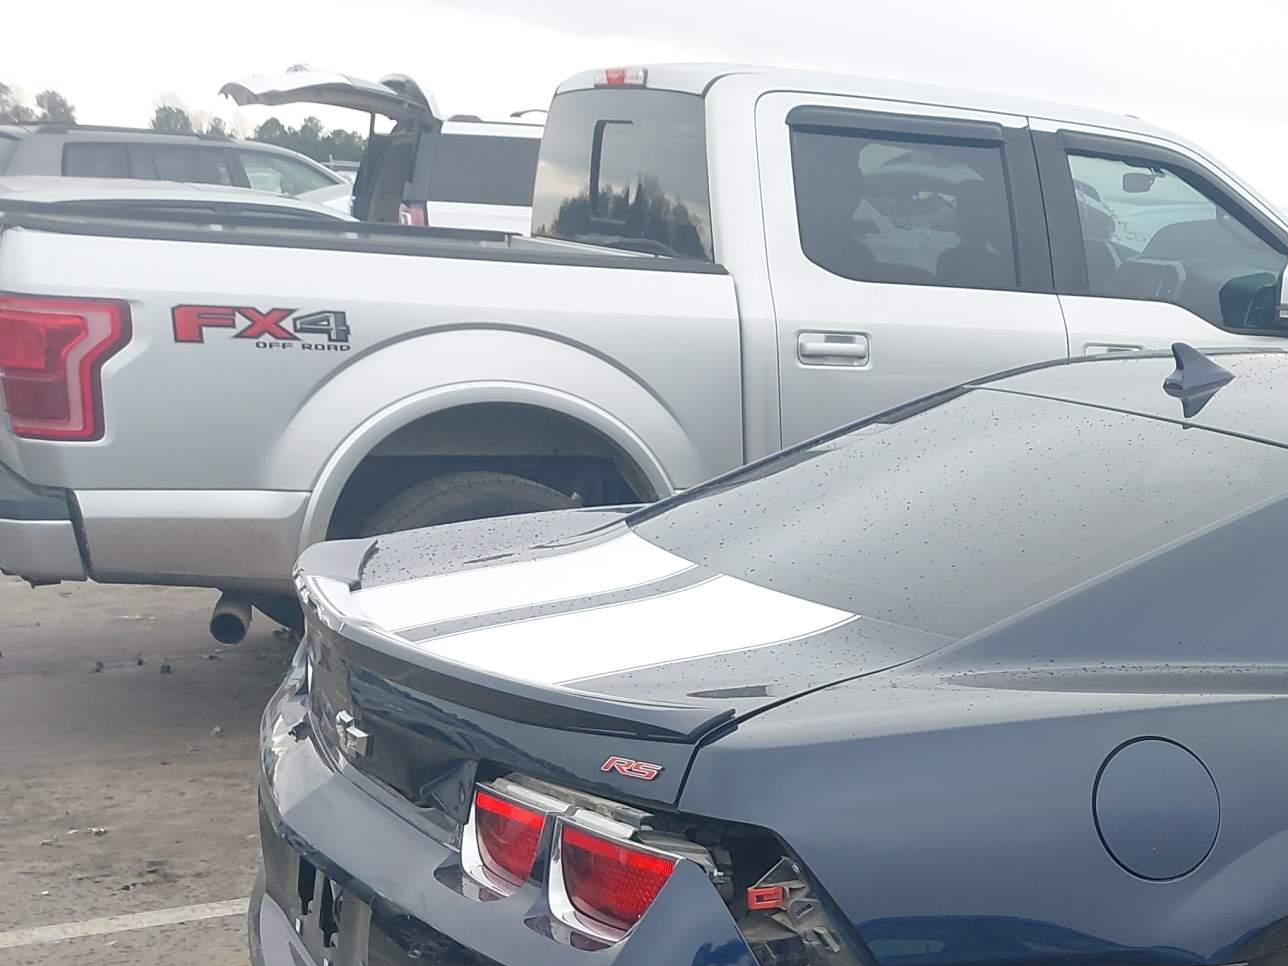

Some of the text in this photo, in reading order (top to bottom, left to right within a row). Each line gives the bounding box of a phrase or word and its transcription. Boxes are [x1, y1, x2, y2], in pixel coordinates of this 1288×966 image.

[171, 304, 351, 344] FX4
[255, 341, 351, 352] OFF ROAD
[600, 755, 664, 781] RS
